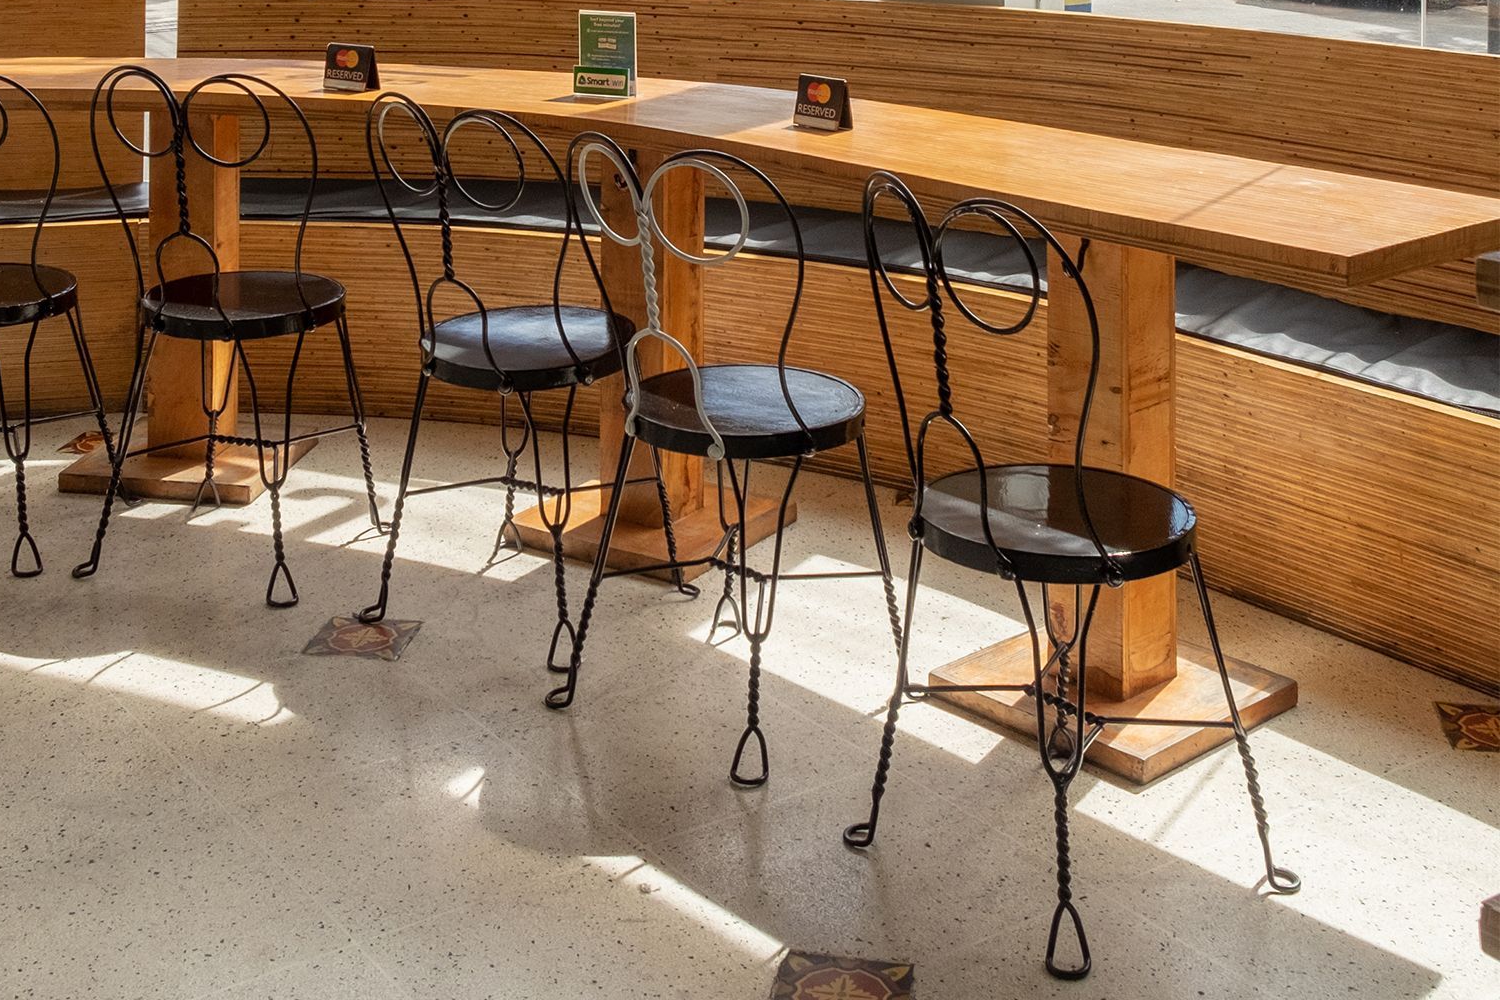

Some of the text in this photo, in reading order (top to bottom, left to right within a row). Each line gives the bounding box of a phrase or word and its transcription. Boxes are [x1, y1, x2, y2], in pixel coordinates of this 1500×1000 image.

[326, 68, 364, 81] RESERVED
[586, 76, 610, 86] Smart
[797, 103, 836, 118] RESERVED
